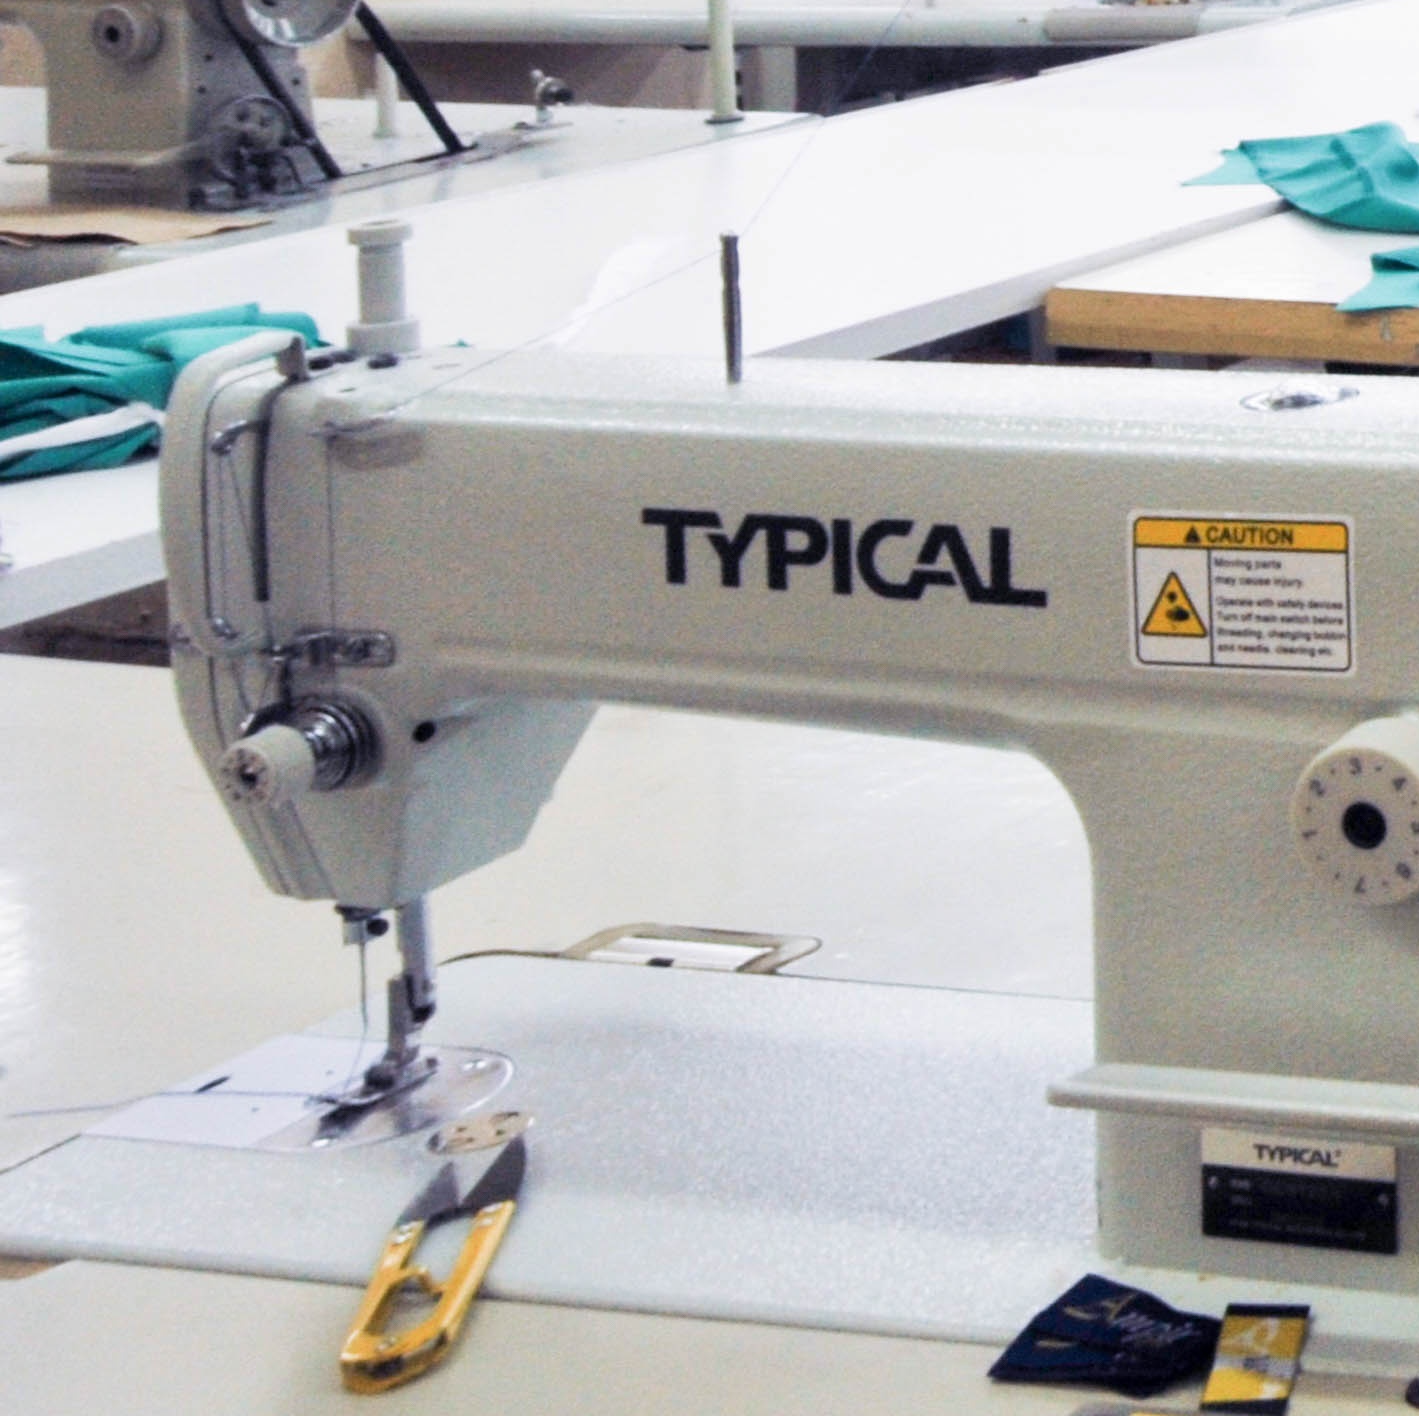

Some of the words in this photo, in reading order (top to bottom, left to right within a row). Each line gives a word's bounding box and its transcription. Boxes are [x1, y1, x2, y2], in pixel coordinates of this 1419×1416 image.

[1206, 525, 1294, 545] CAUTION
[641, 507, 1048, 608] TYPICAL
[1214, 557, 1252, 571] Moving
[1255, 559, 1282, 571] parts
[1215, 576, 1236, 587] may
[1239, 577, 1271, 587] cause
[1253, 1143, 1339, 1168] TYPICAL
